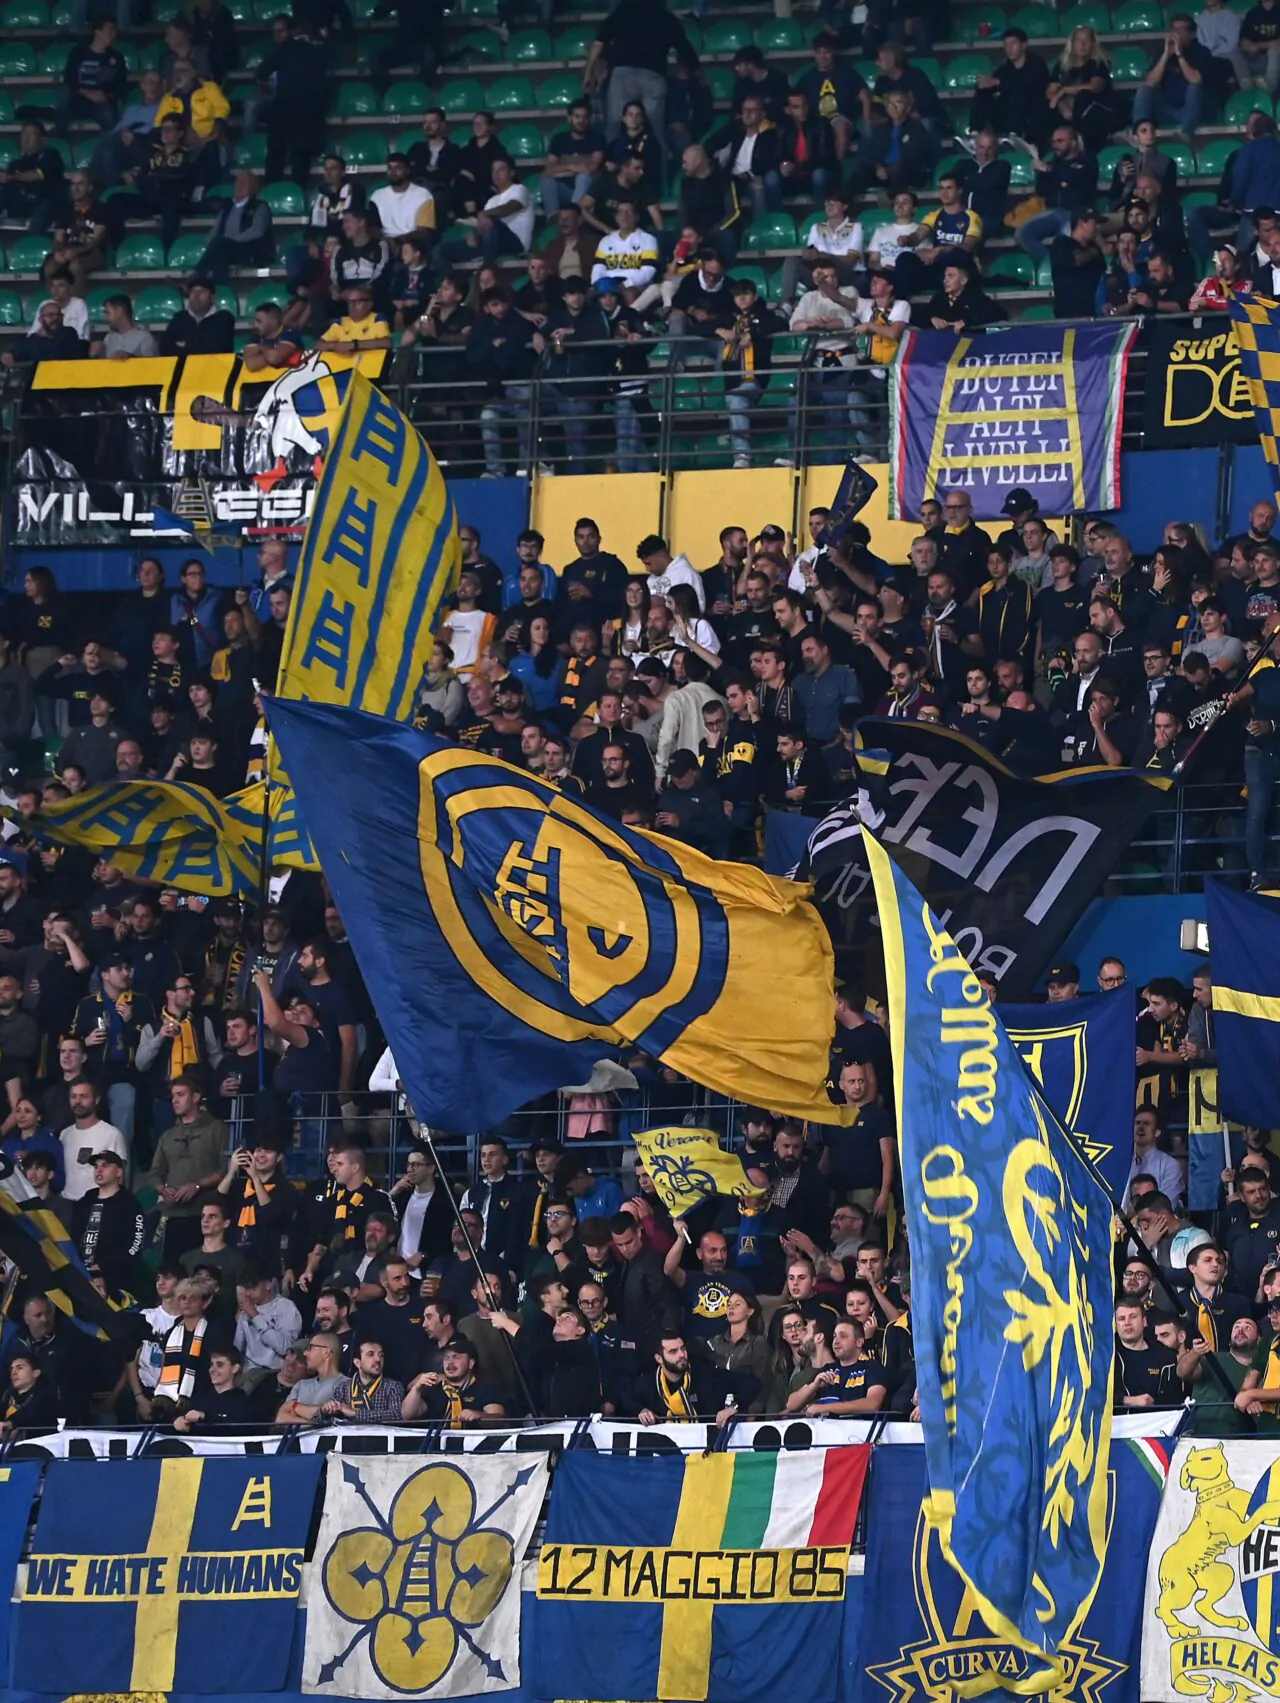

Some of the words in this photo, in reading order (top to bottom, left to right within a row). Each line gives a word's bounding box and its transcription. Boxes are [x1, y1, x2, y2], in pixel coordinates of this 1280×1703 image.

[1169, 331, 1240, 362] SUPE
[959, 351, 1062, 394] BUTEI
[969, 394, 1043, 438] ALTI
[942, 438, 1071, 486] LIVELLI
[26, 1558, 78, 1596] WE
[84, 1556, 168, 1595] HATE
[176, 1553, 303, 1595] HUMANS
[540, 1547, 597, 1595] 12
[602, 1549, 778, 1599] MAGGIO
[788, 1547, 847, 1598] 85
[928, 1650, 1020, 1682] CURVA
[1182, 1641, 1280, 1687] HELLAS
